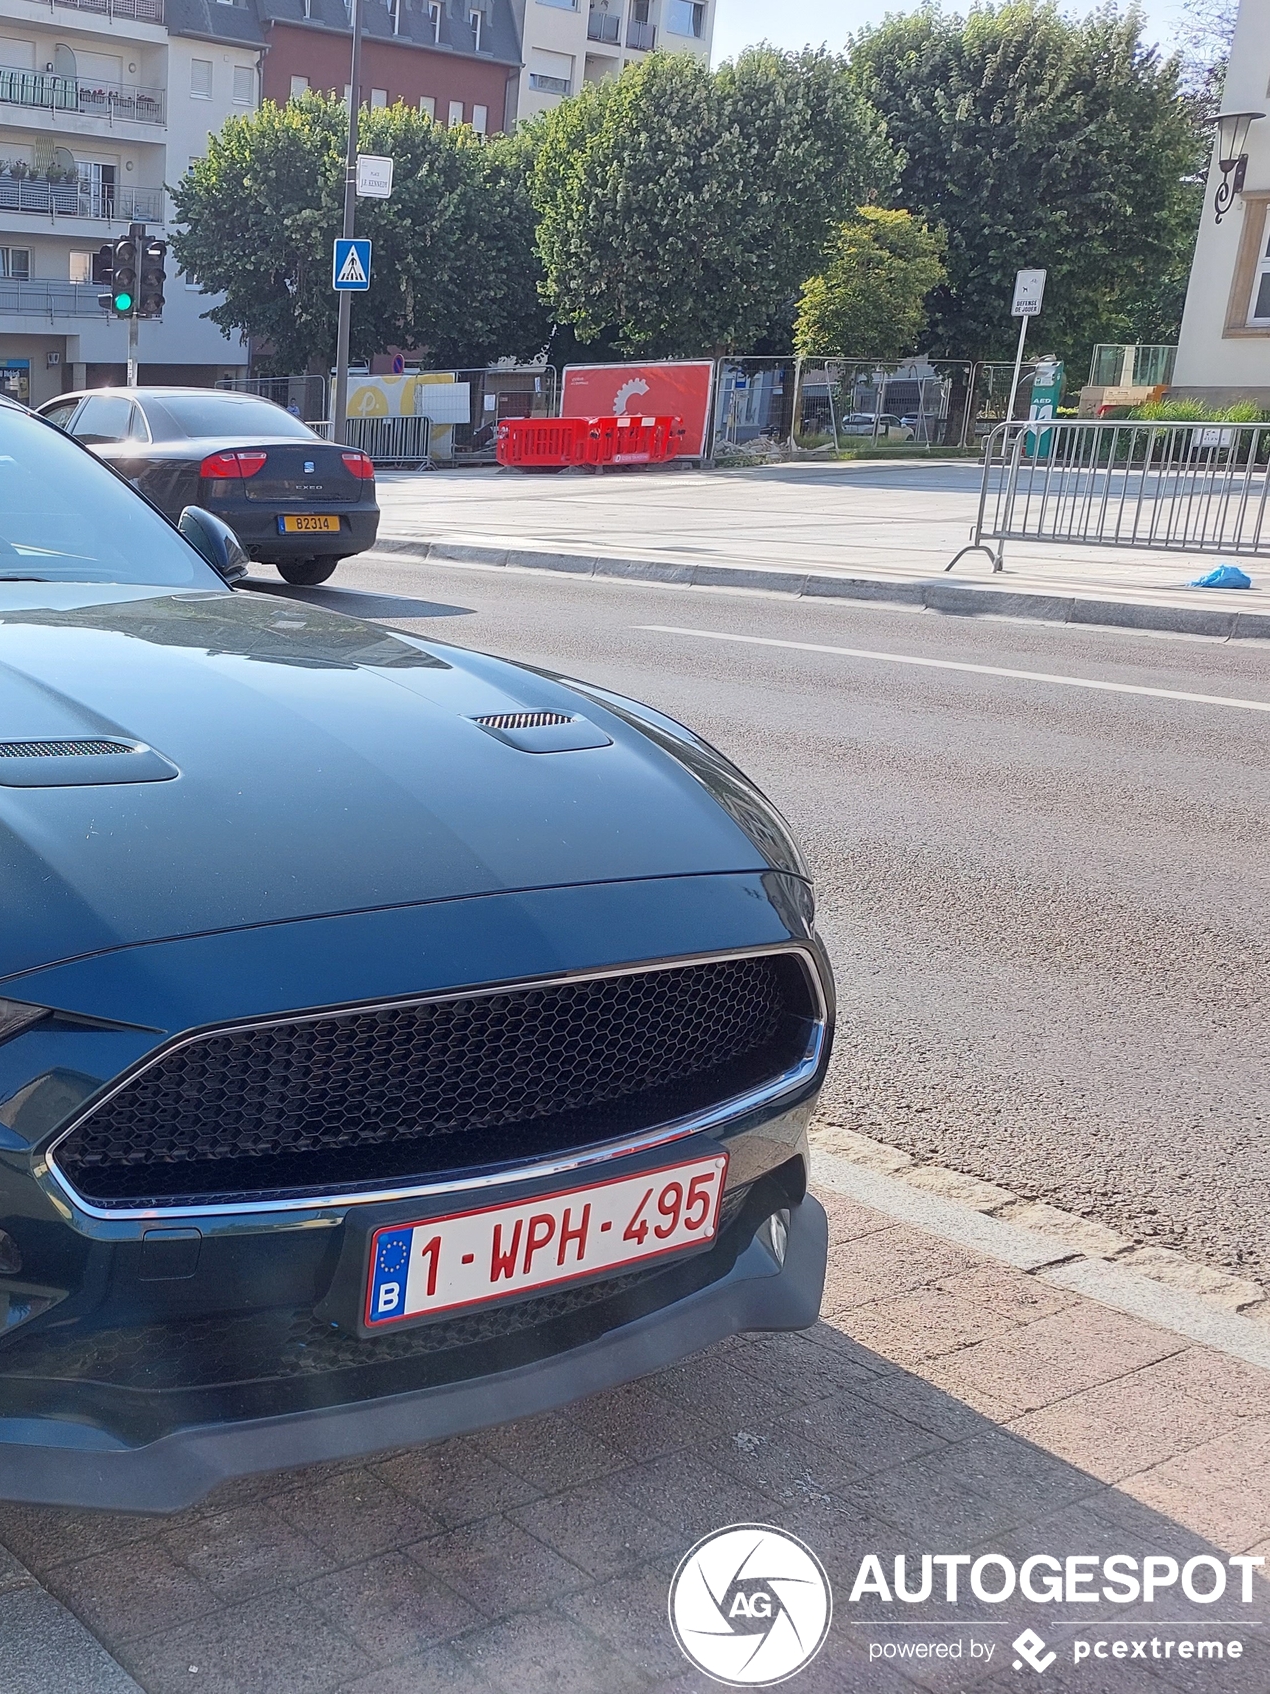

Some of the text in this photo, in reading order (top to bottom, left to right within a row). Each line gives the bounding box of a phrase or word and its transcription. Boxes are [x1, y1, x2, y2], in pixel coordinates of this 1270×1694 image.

[368, 180, 388, 188] KENNEDY
[296, 518, 329, 529] 82314
[422, 1172, 715, 1296] 1-WPH-495
[378, 1281, 400, 1313] B
